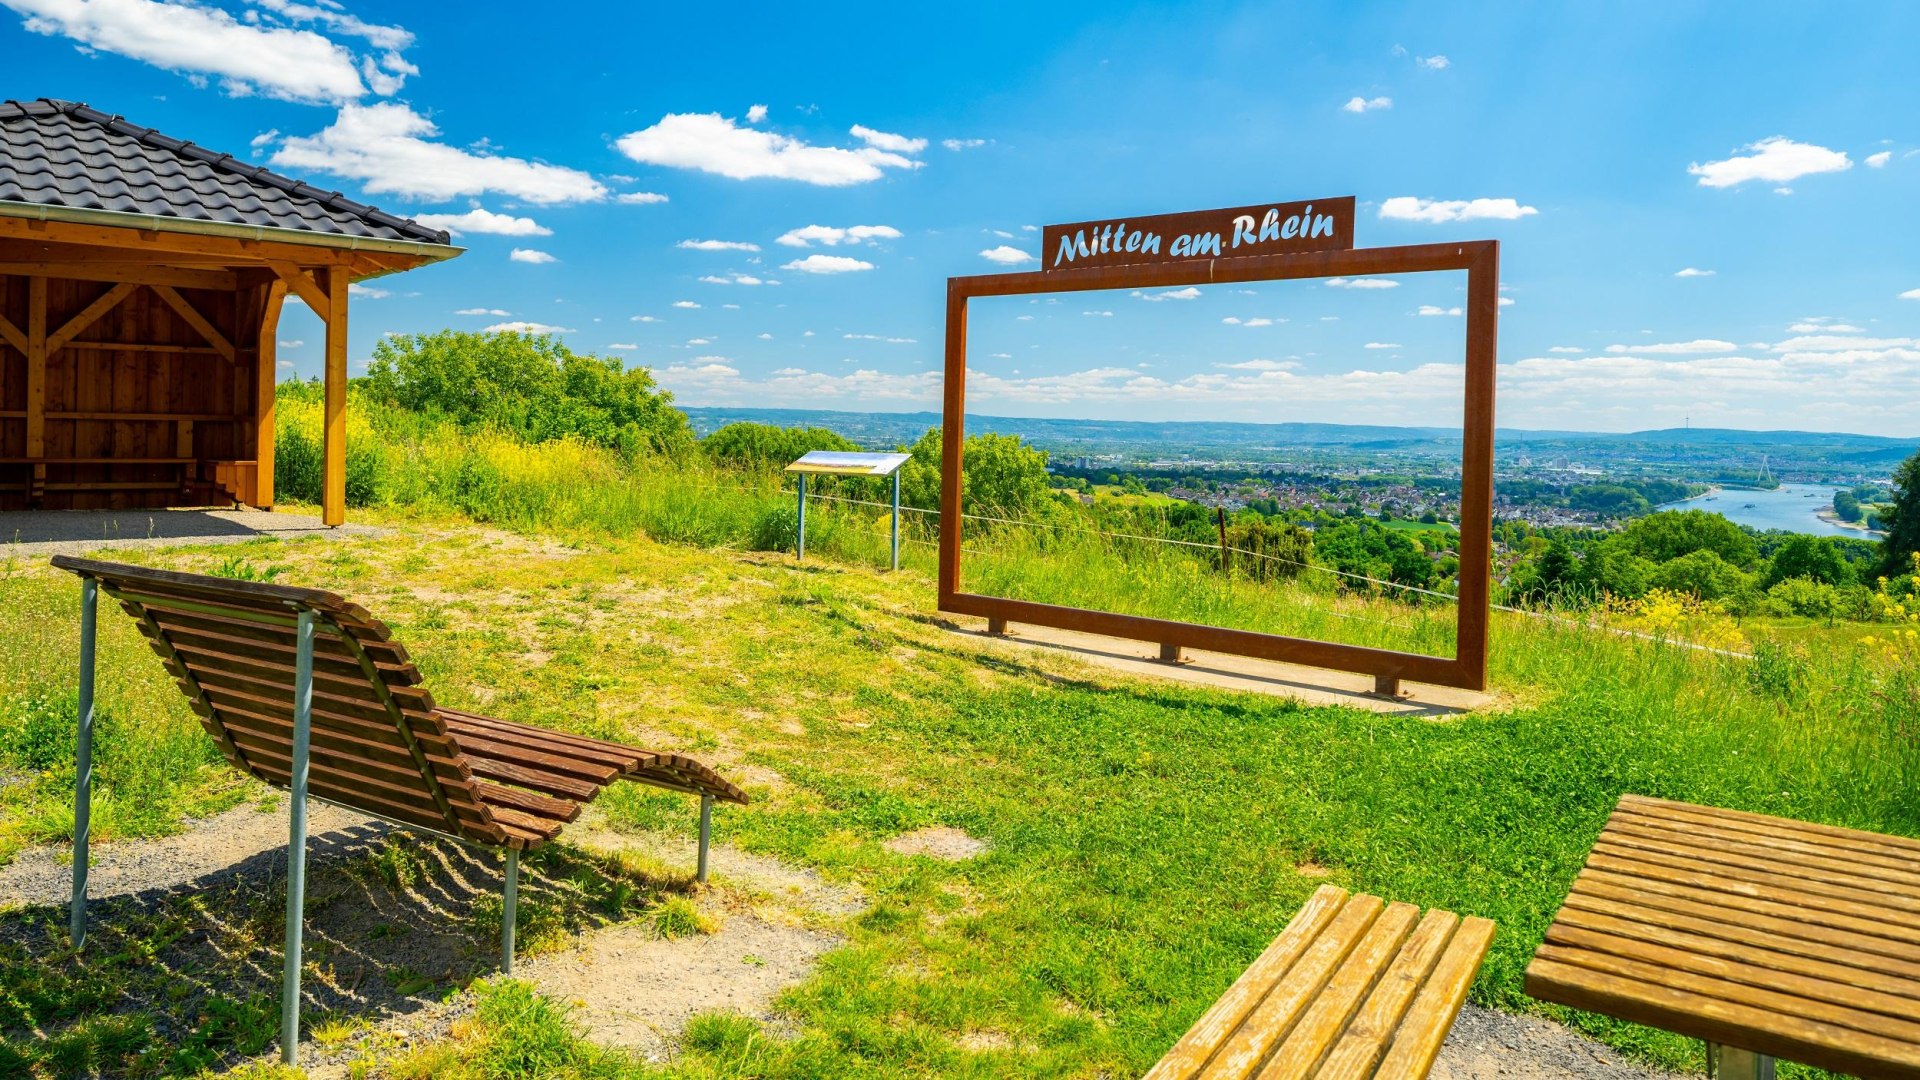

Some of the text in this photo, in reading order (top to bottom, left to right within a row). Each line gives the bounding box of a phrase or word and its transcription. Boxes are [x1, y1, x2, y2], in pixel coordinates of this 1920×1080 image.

[1054, 204, 1334, 267] Mitten am Rhein
